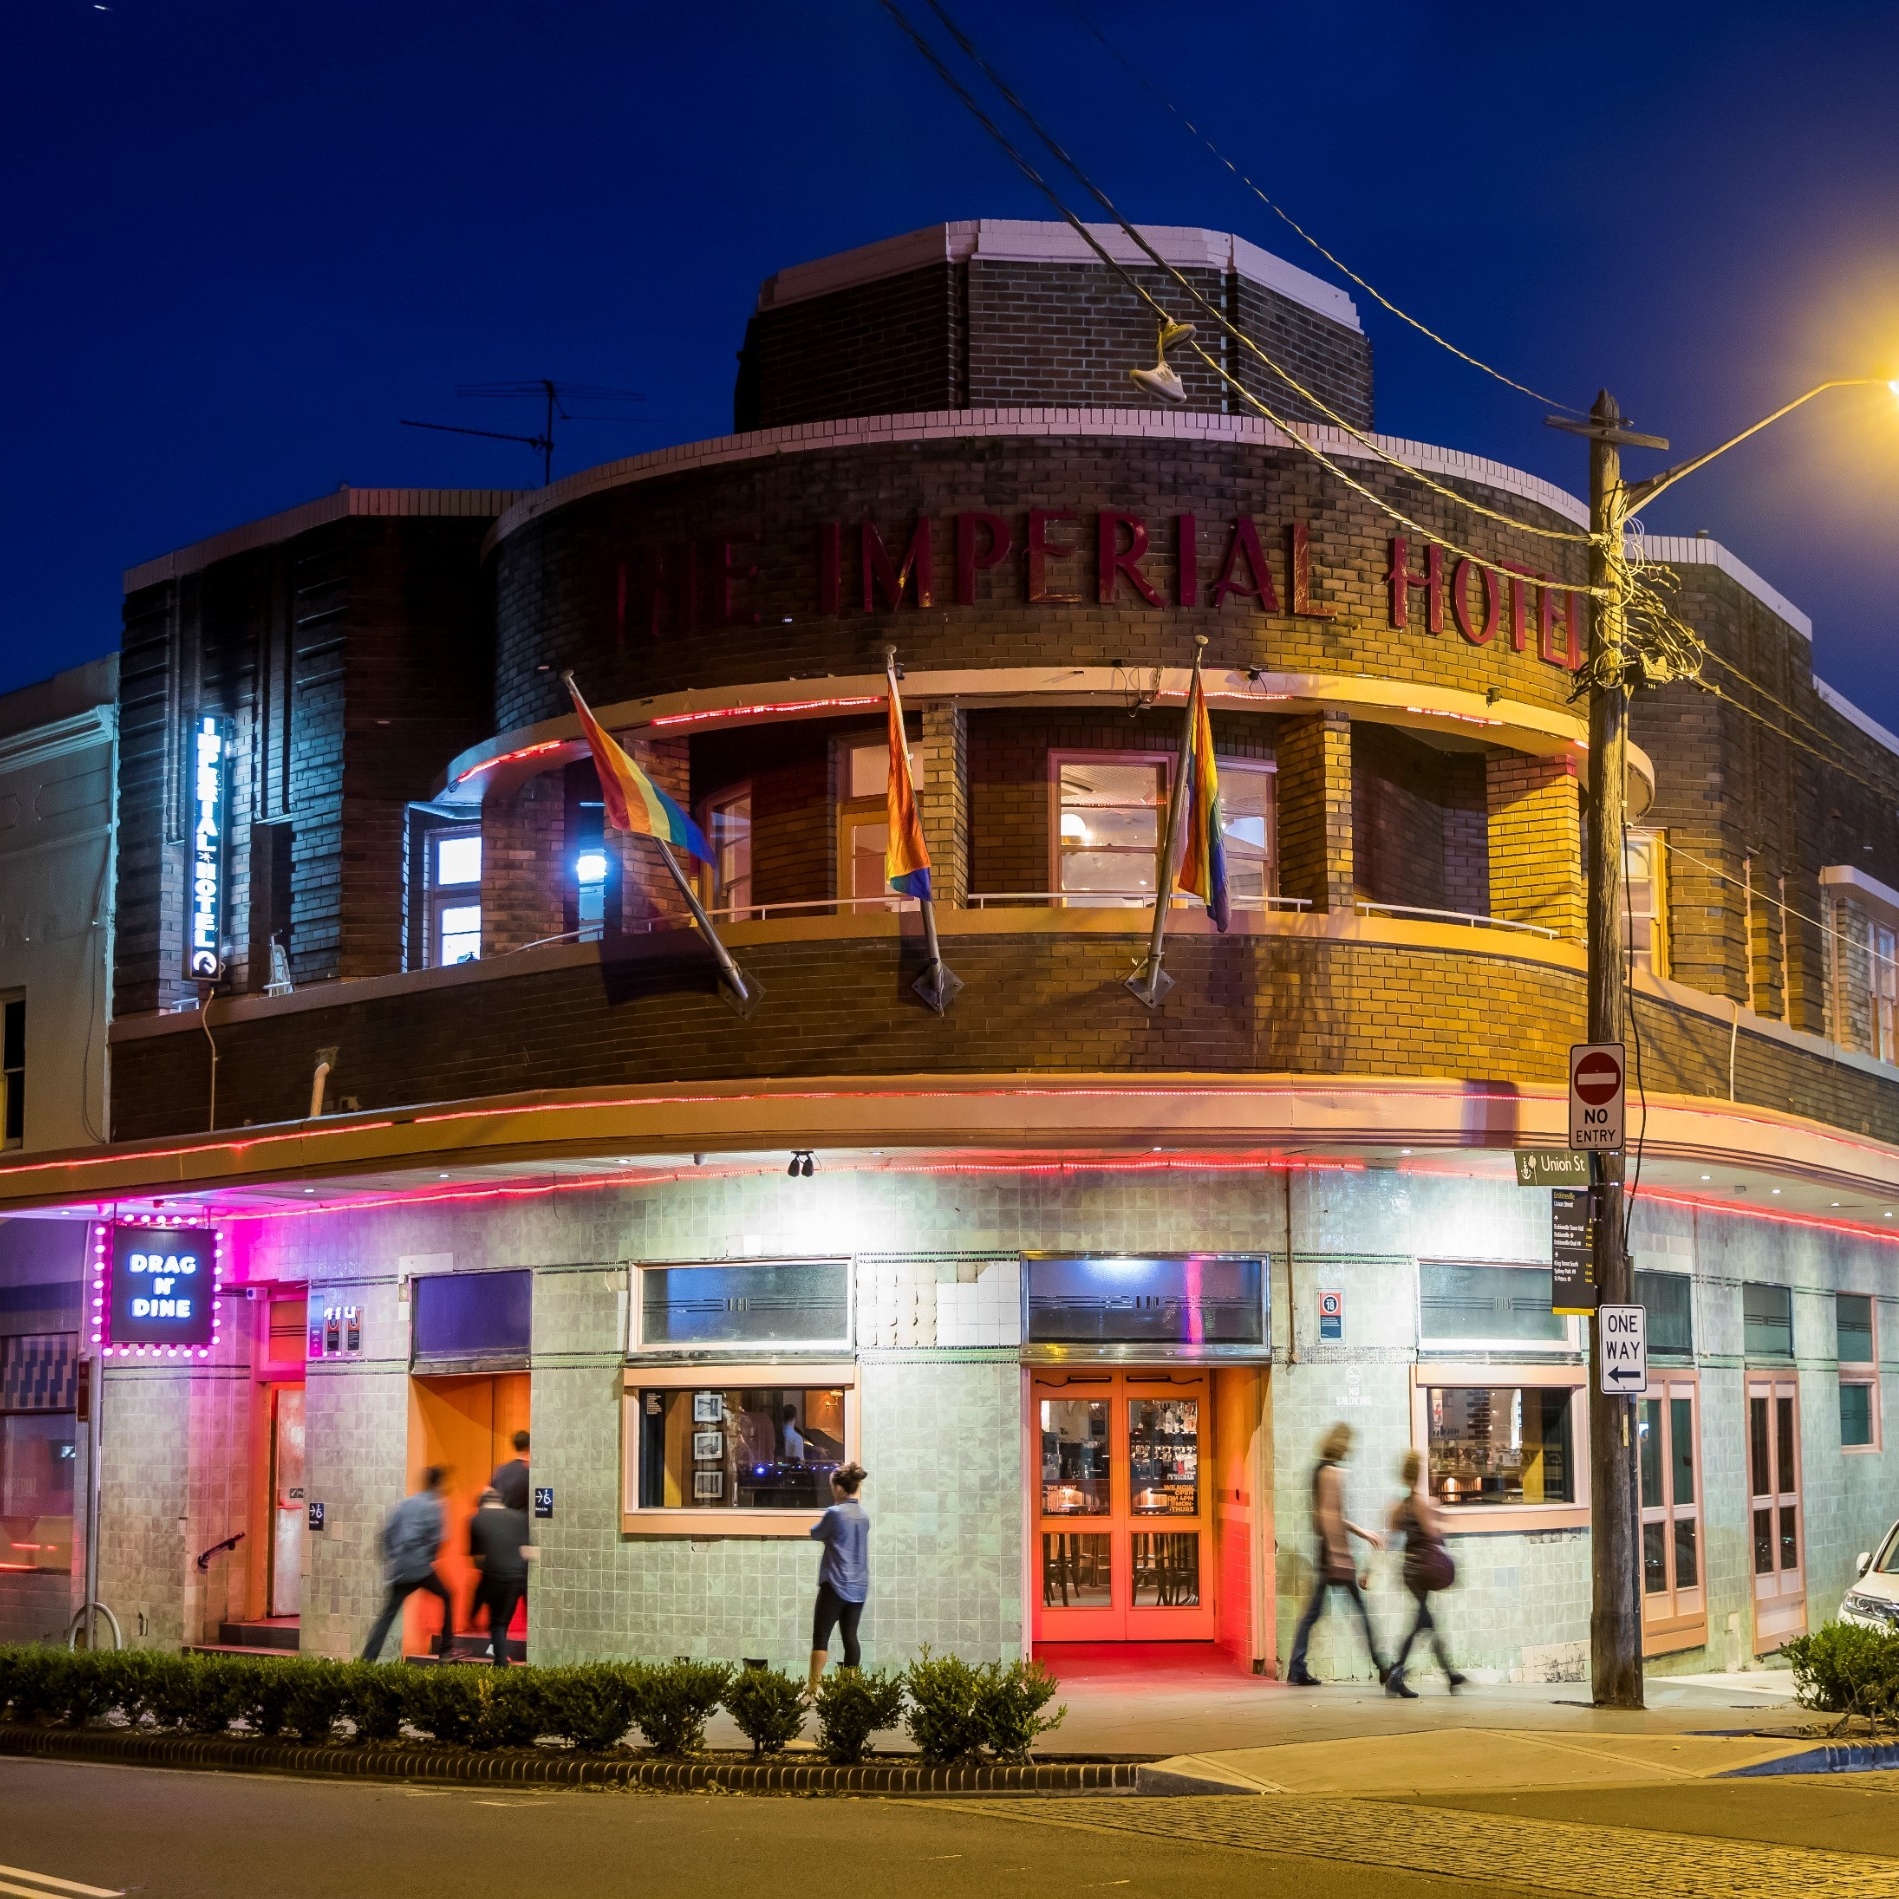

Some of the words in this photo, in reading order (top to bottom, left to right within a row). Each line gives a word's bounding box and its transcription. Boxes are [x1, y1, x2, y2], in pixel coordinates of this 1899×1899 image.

[604, 531, 762, 643] THE
[818, 508, 1338, 620] IMPERIAL
[1584, 1108, 1608, 1124] NO
[1576, 1129, 1616, 1143] ENTRY
[1540, 1155, 1572, 1172] Union
[1573, 1155, 1586, 1172] St
[129, 1254, 196, 1274] DRAG
[131, 1298, 191, 1318] DINE
[1325, 1301, 1335, 1311] 18
[1607, 1314, 1638, 1333] ONE
[1605, 1341, 1641, 1360] WAY
[1348, 1386, 1360, 1396] NO
[1335, 1396, 1372, 1406] SMOKING
